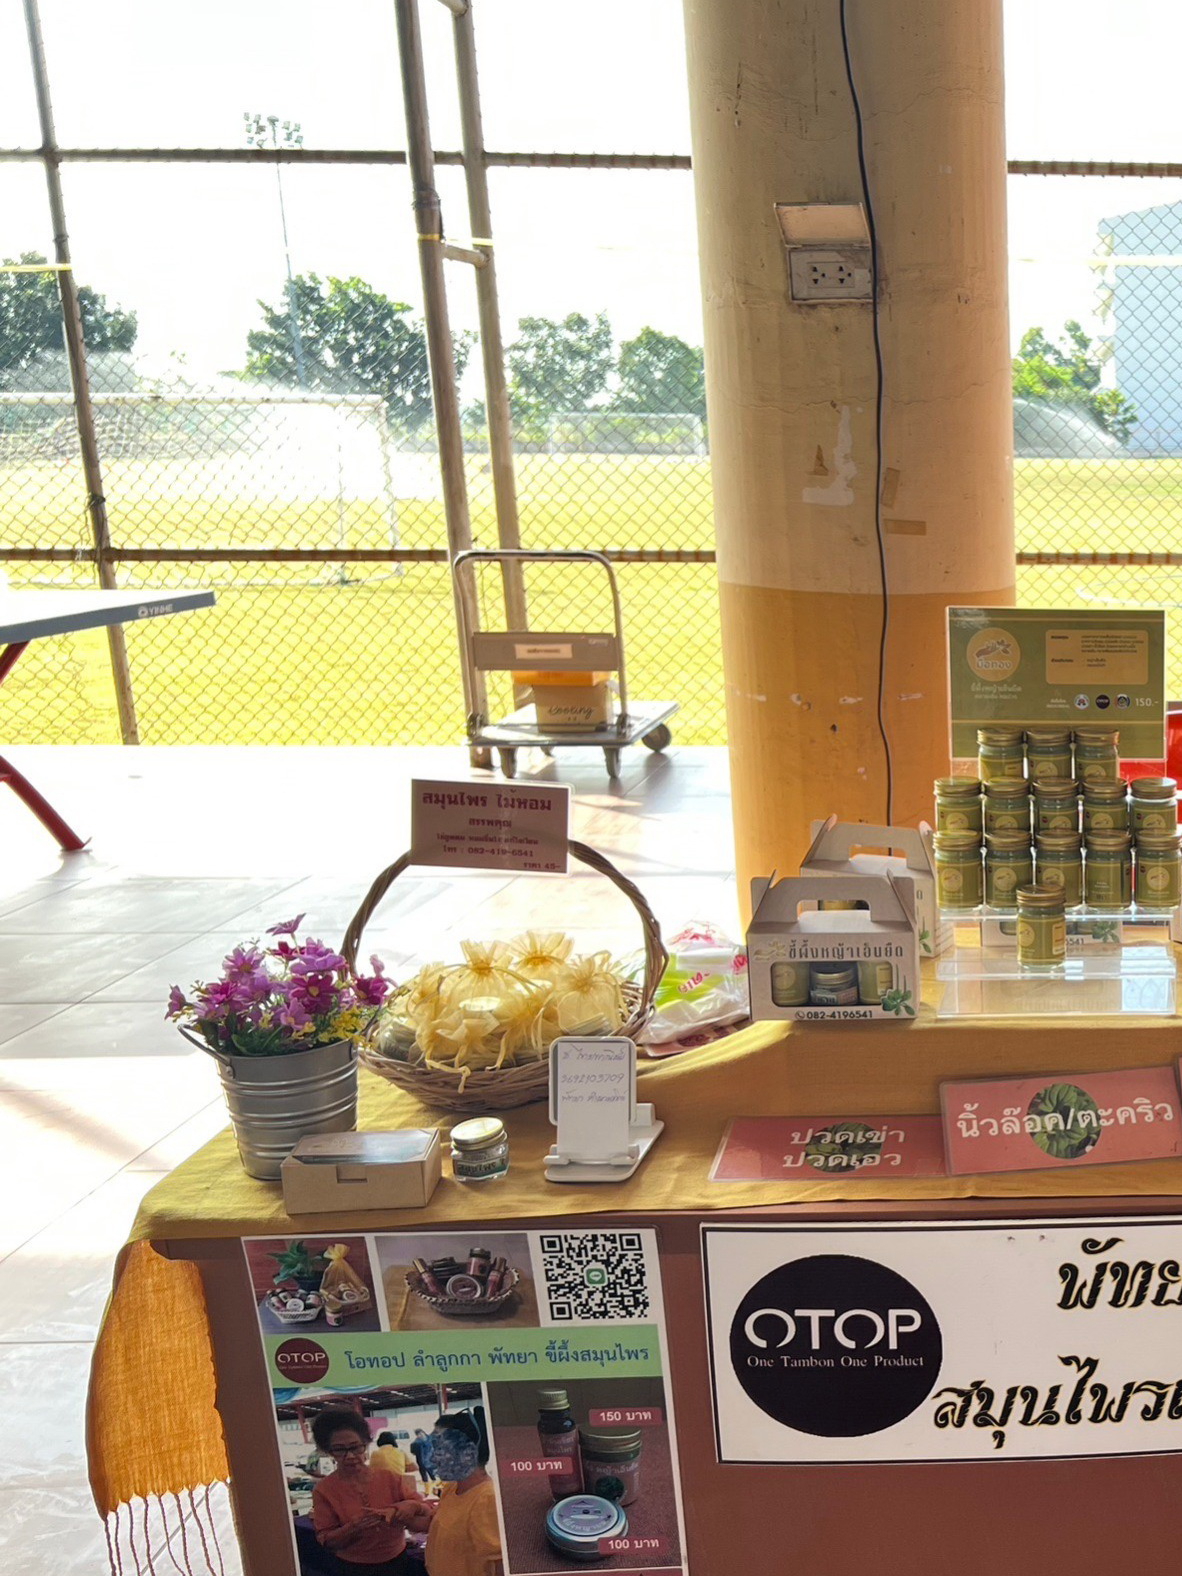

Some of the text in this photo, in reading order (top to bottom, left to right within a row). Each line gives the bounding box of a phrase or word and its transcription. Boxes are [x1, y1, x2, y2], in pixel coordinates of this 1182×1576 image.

[148, 604, 174, 615] YINHE
[1134, 697, 1159, 707] 150.-
[548, 705, 594, 719] Cooking
[421, 788, 553, 812] สมุนไพร ไม้หอม
[467, 817, 513, 830] สรรพคุณ
[788, 939, 904, 961] ขี้ผึ้งหญ้าเอ็นยืด
[806, 1010, 874, 1020] 082-4196541
[956, 1096, 1175, 1139] นิ้วล๊อค/ตะคริว
[790, 1125, 906, 1145] ปวดเข่า
[782, 1151, 903, 1169] ปวดเอว
[743, 1307, 923, 1351] OTOP
[277, 1352, 326, 1364] OTOP
[344, 1339, 650, 1373] โอทอป ลำลูกกา พัทยา ขี้ผึ้งสมุนไพร
[746, 1354, 925, 1368] One Tambon One Product
[600, 1410, 652, 1422] 150 บาท
[510, 1460, 563, 1472] 100 บาท
[608, 1538, 660, 1550] 100 บาท
